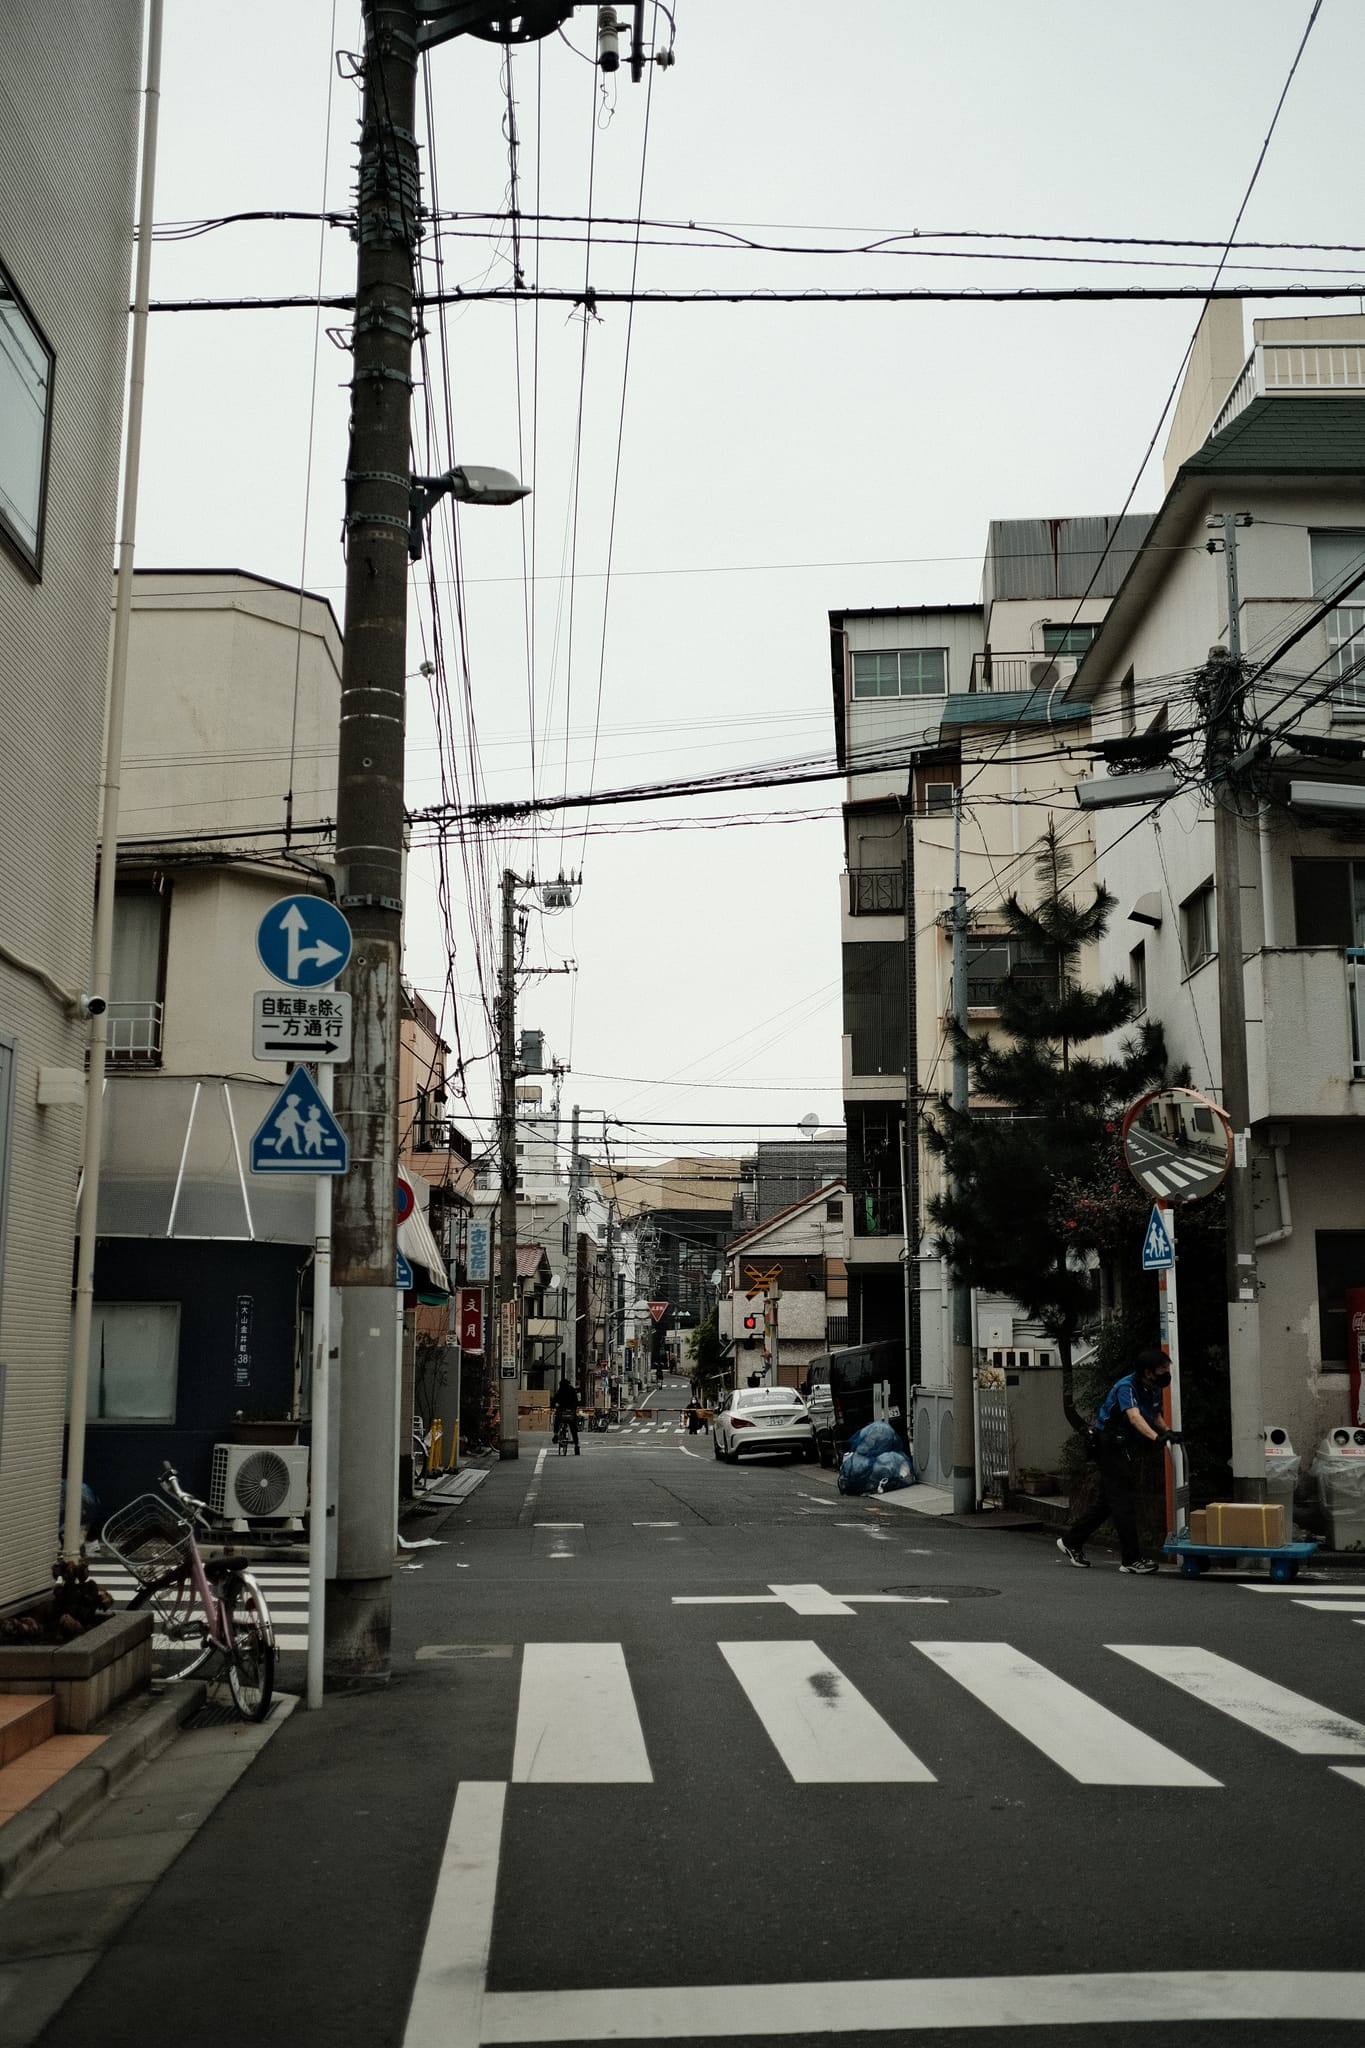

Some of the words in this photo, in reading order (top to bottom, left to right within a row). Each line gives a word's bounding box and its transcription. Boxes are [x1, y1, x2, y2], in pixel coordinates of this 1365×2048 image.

[262, 996, 343, 1016] 自転車を除く
[262, 1018, 343, 1037] 一方通行
[463, 1298, 480, 1338] 文月
[237, 1354, 248, 1364] 38
